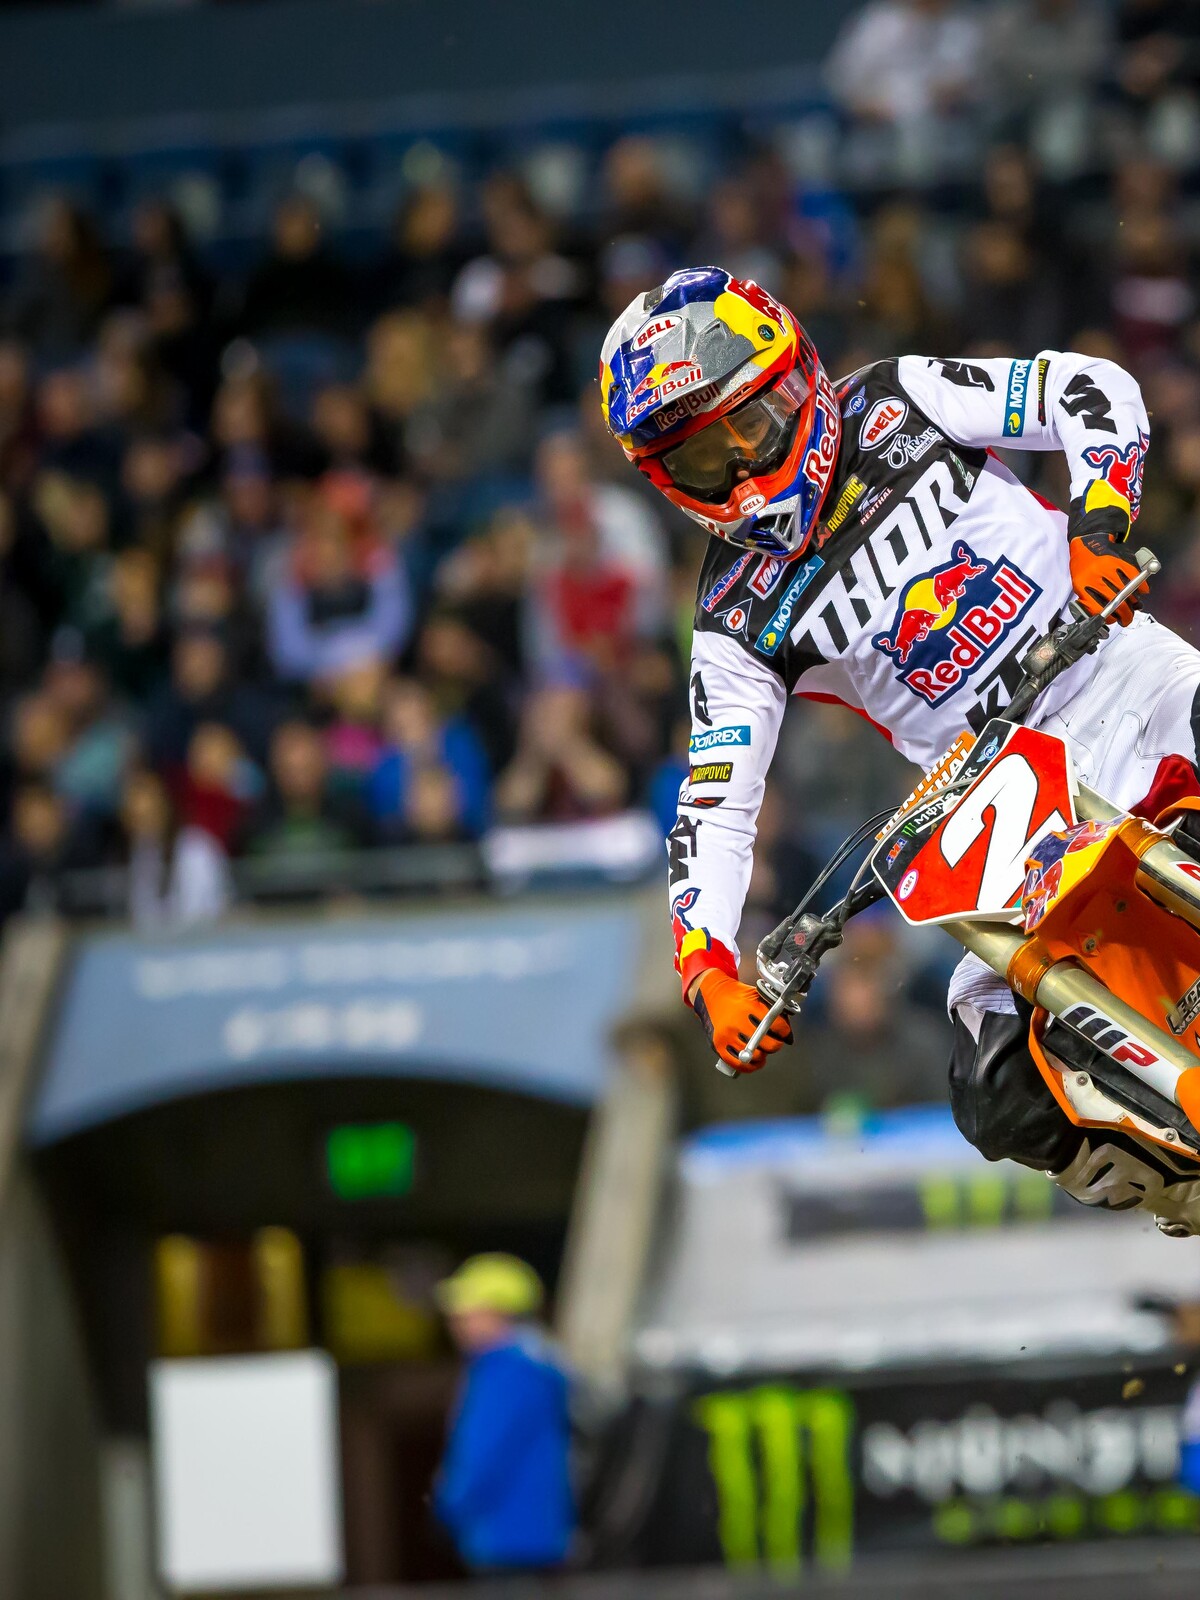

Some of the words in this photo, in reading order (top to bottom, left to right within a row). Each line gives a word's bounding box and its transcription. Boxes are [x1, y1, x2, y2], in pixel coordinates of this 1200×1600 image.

[637, 319, 676, 347] BELL
[626, 388, 660, 425] Red
[662, 367, 702, 396] Bull
[654, 399, 688, 431] Red
[686, 382, 721, 413] Bull
[1009, 360, 1029, 408] MOTOR
[865, 404, 903, 442] BELL
[742, 498, 762, 512] BELL
[860, 488, 894, 526] RENTHAL
[757, 558, 784, 590] 100
[790, 461, 967, 655] THOR
[772, 563, 815, 631] MOTORX
[905, 629, 976, 702] Red
[959, 565, 1037, 649] Bull
[940, 753, 1070, 911] 2
